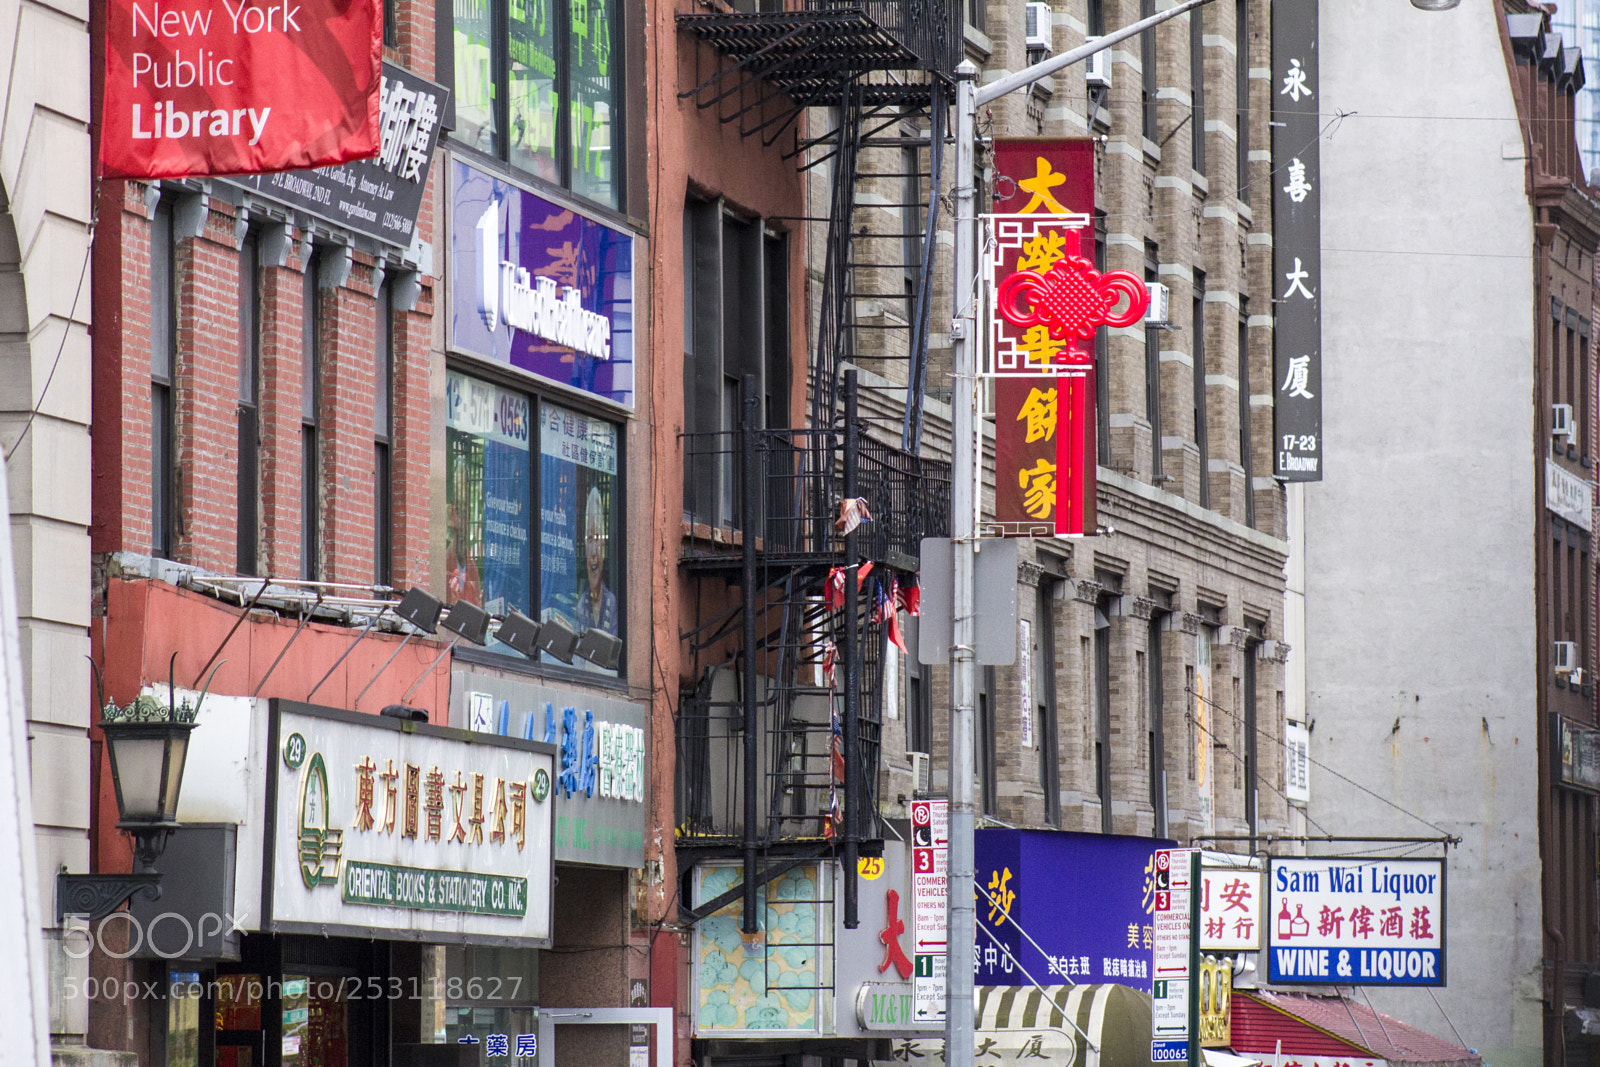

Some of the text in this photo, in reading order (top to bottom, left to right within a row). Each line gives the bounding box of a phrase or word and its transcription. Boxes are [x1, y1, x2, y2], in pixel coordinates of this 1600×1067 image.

[132, 0, 302, 38] New York
[133, 48, 234, 88] Public
[131, 100, 272, 146] Library
[1282, 434, 1316, 451] 17-23
[289, 737, 302, 762] 29
[537, 774, 547, 794] 29
[352, 755, 527, 852] 東方圖書文具公司
[861, 857, 882, 875] 25
[919, 851, 930, 871] 3
[349, 867, 523, 911] ORIENTAL BOOKS & STATIONERY CO. INC.
[1276, 865, 1437, 901] Sam Wai Liquor
[916, 901, 946, 909] OTHERS NO
[1158, 892, 1167, 909] 3
[1156, 913, 1190, 921] COMMERCIAL
[1156, 922, 1182, 931] VEHICLES
[1316, 904, 1434, 940] 新偉酒莊
[917, 923, 936, 932] Except
[1156, 952, 1187, 960] Except Sunday
[1276, 949, 1436, 981] WINE & LIQUOR
[920, 956, 927, 976] 1
[916, 993, 936, 1002] Except
[1158, 980, 1164, 998] 1
[1155, 1011, 1186, 1019] Except Sunday
[1153, 1048, 1187, 1060] 100065
